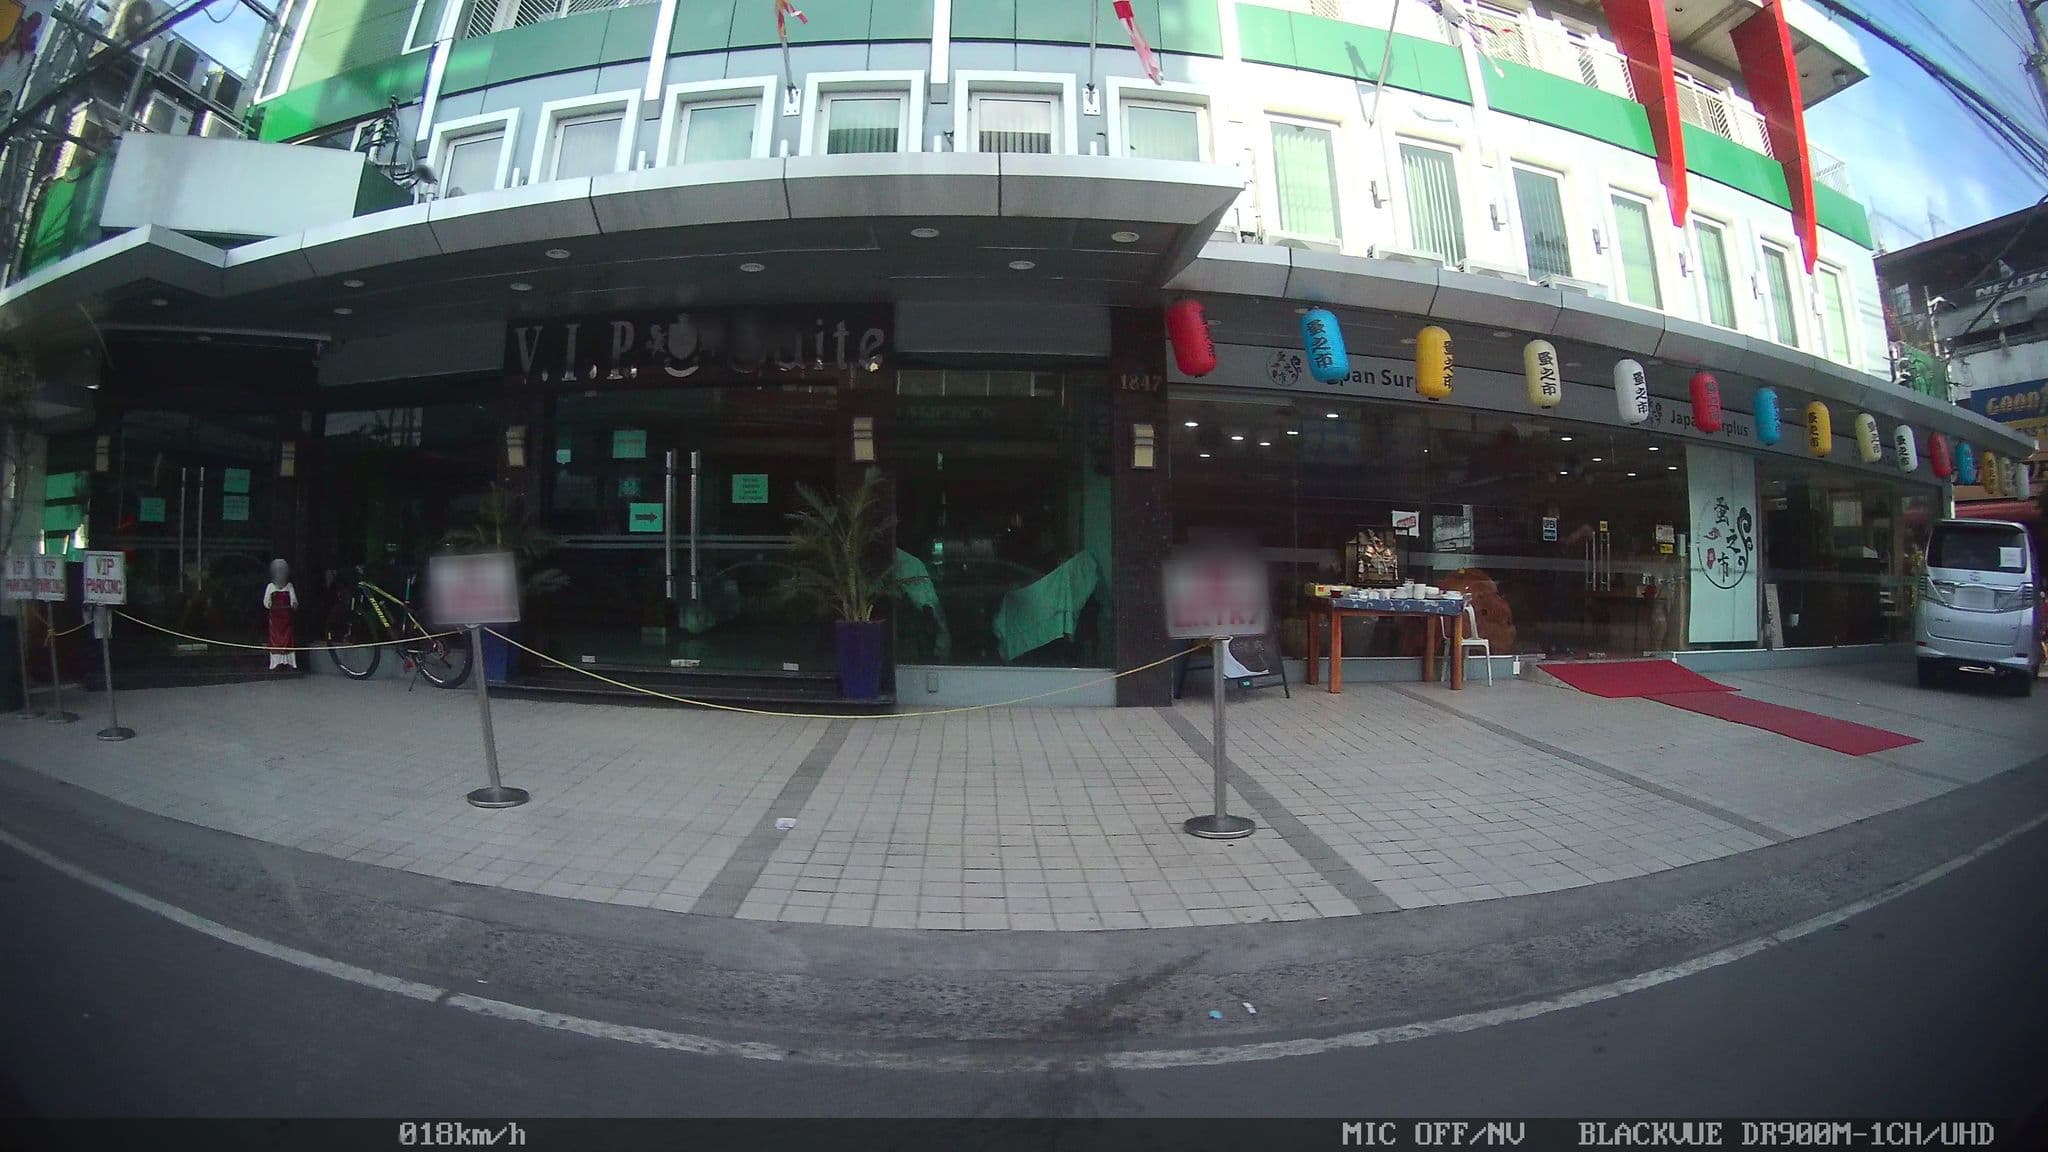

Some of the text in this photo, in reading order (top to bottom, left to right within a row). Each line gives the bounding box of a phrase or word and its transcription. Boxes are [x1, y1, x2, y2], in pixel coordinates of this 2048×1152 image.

[729, 318, 885, 376] uite
[96, 558, 115, 576] VIP
[86, 578, 122, 594] PARKING
